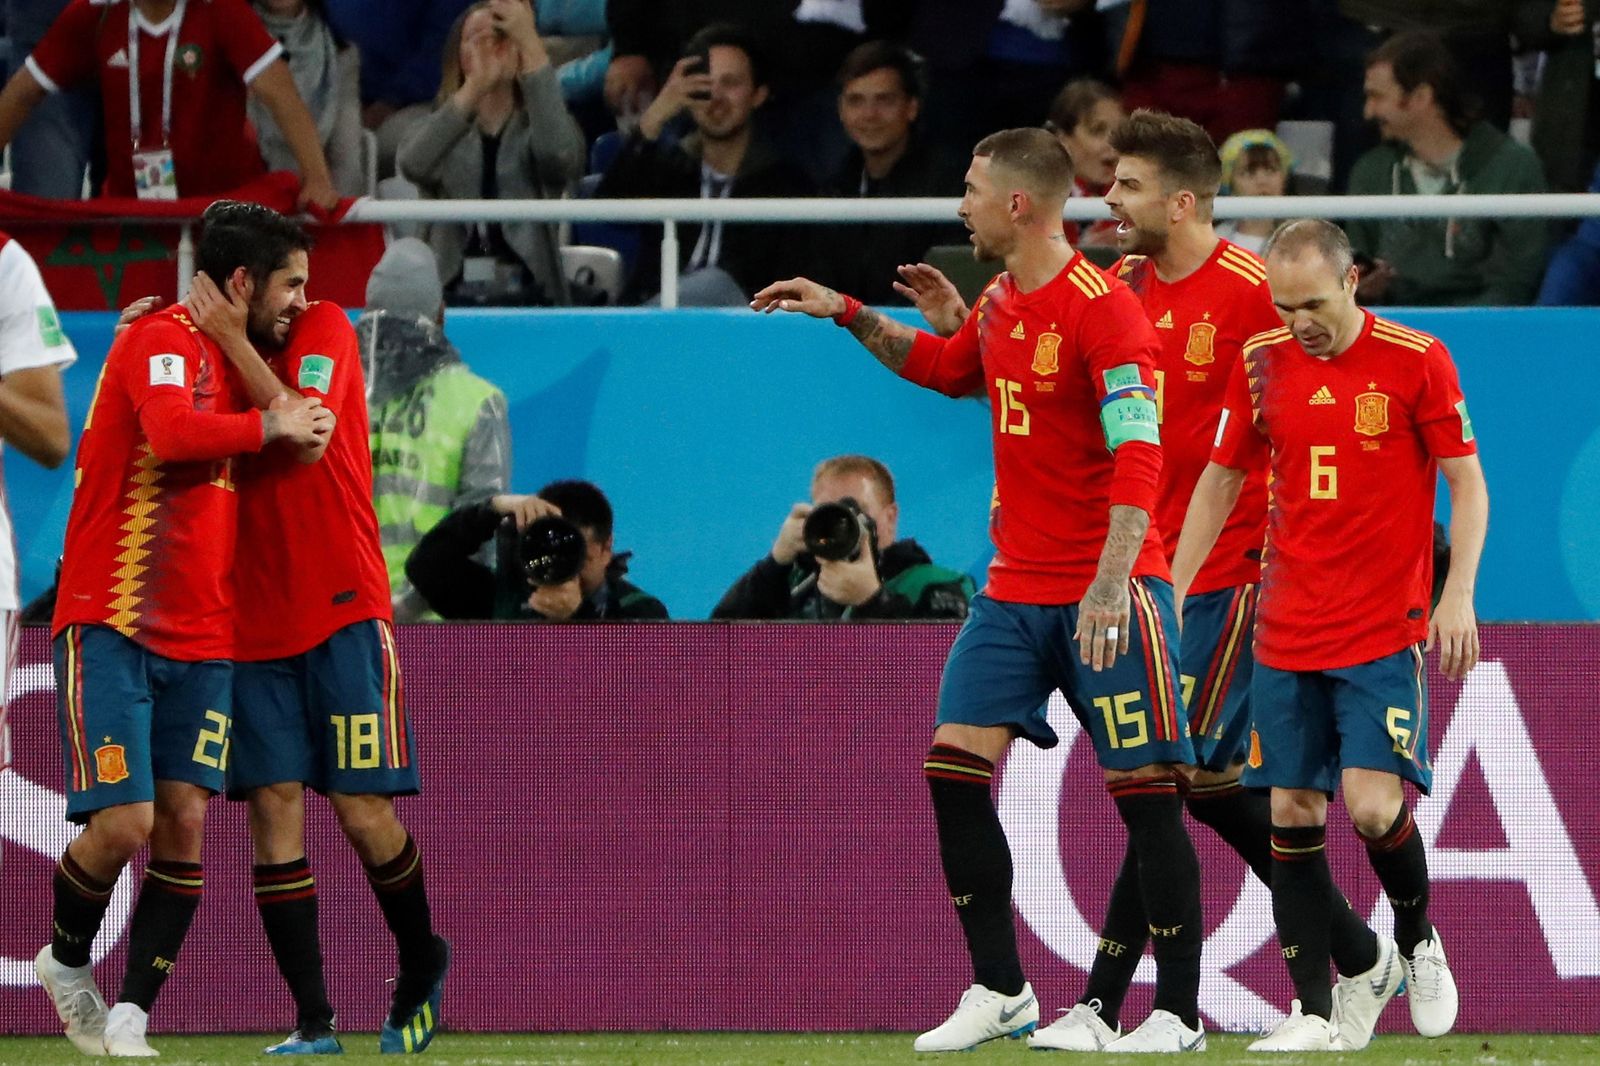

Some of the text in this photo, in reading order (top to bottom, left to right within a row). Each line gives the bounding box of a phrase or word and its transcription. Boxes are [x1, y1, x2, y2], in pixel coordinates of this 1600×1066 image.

[996, 378, 1030, 435] 15
[1310, 446, 1337, 499] 6
[330, 713, 380, 769] 18
[1093, 691, 1149, 749] 15
[952, 894, 973, 906] EF
